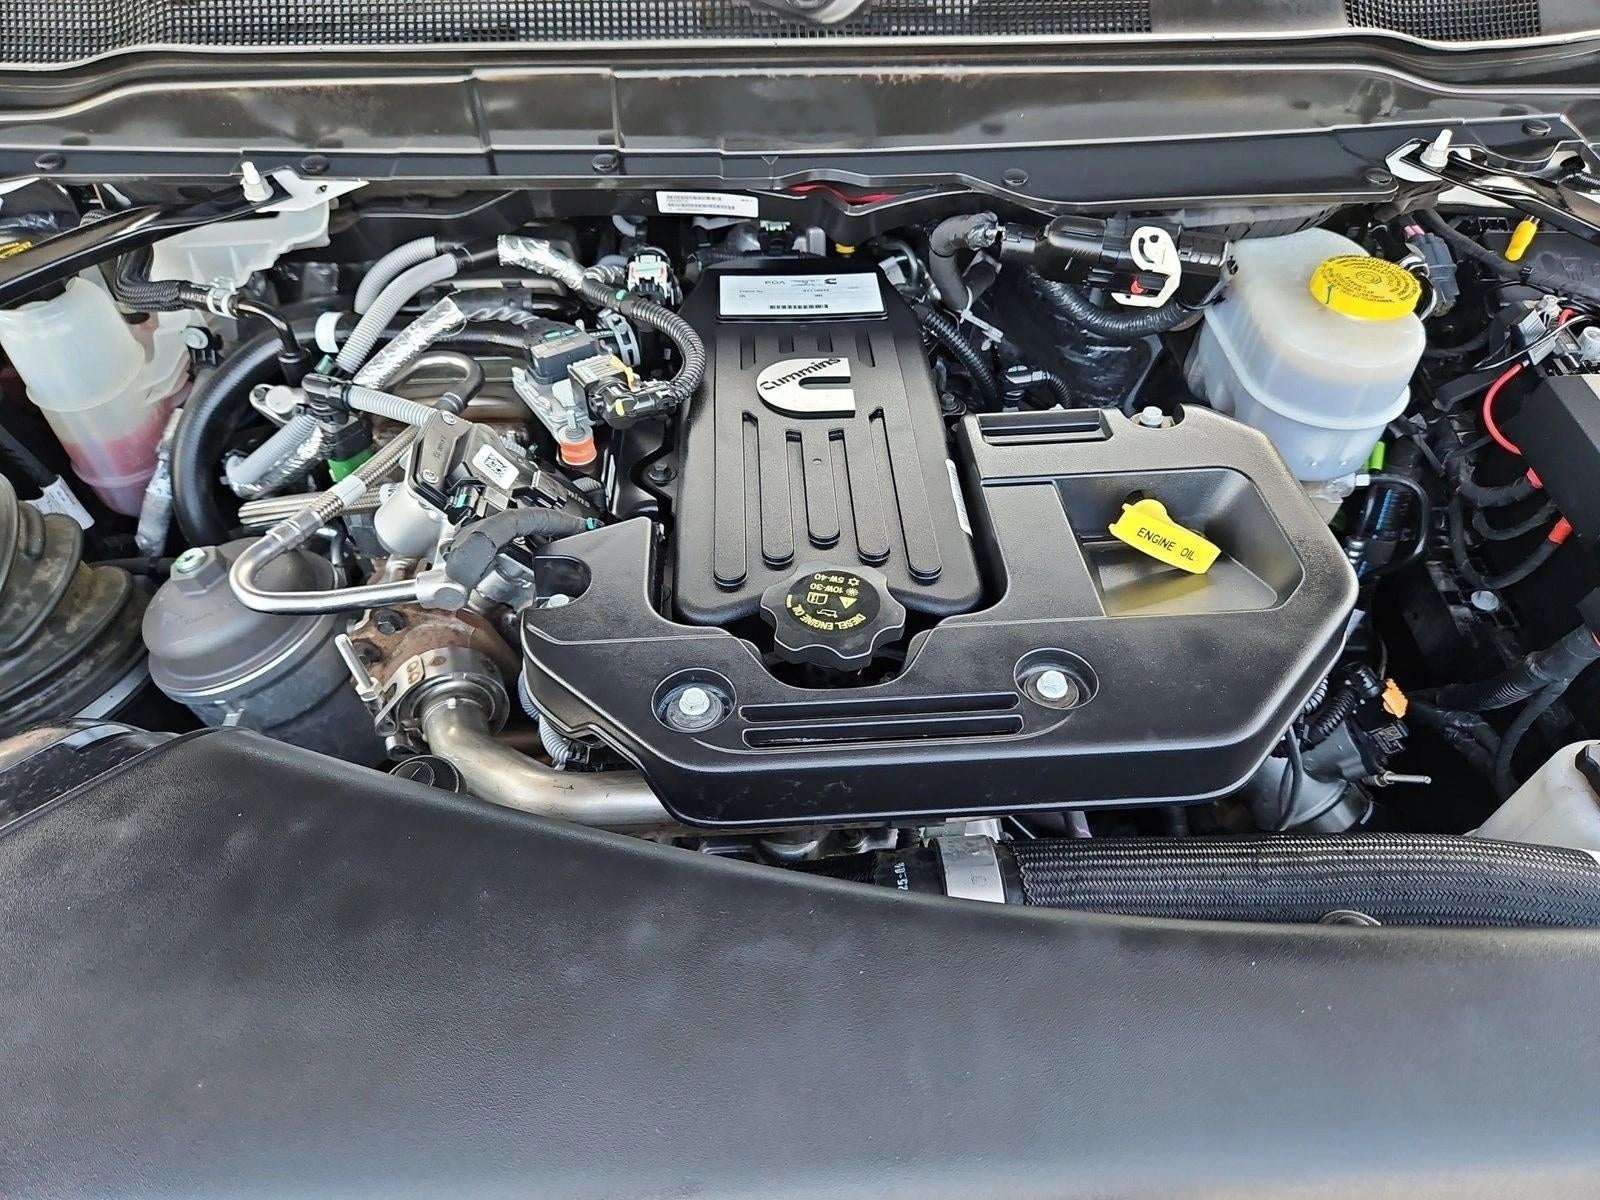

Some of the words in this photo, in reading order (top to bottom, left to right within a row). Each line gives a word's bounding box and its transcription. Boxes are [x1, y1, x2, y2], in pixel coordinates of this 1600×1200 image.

[760, 358, 841, 390] Cummins
[1136, 527, 1176, 552] ENGINE
[1180, 547, 1196, 561] OIL
[814, 573, 845, 584] 5W-40
[809, 582, 844, 594] 10W-30
[791, 603, 806, 617] OIL
[800, 613, 834, 631] ENGINE
[835, 612, 867, 630] DIESEL
